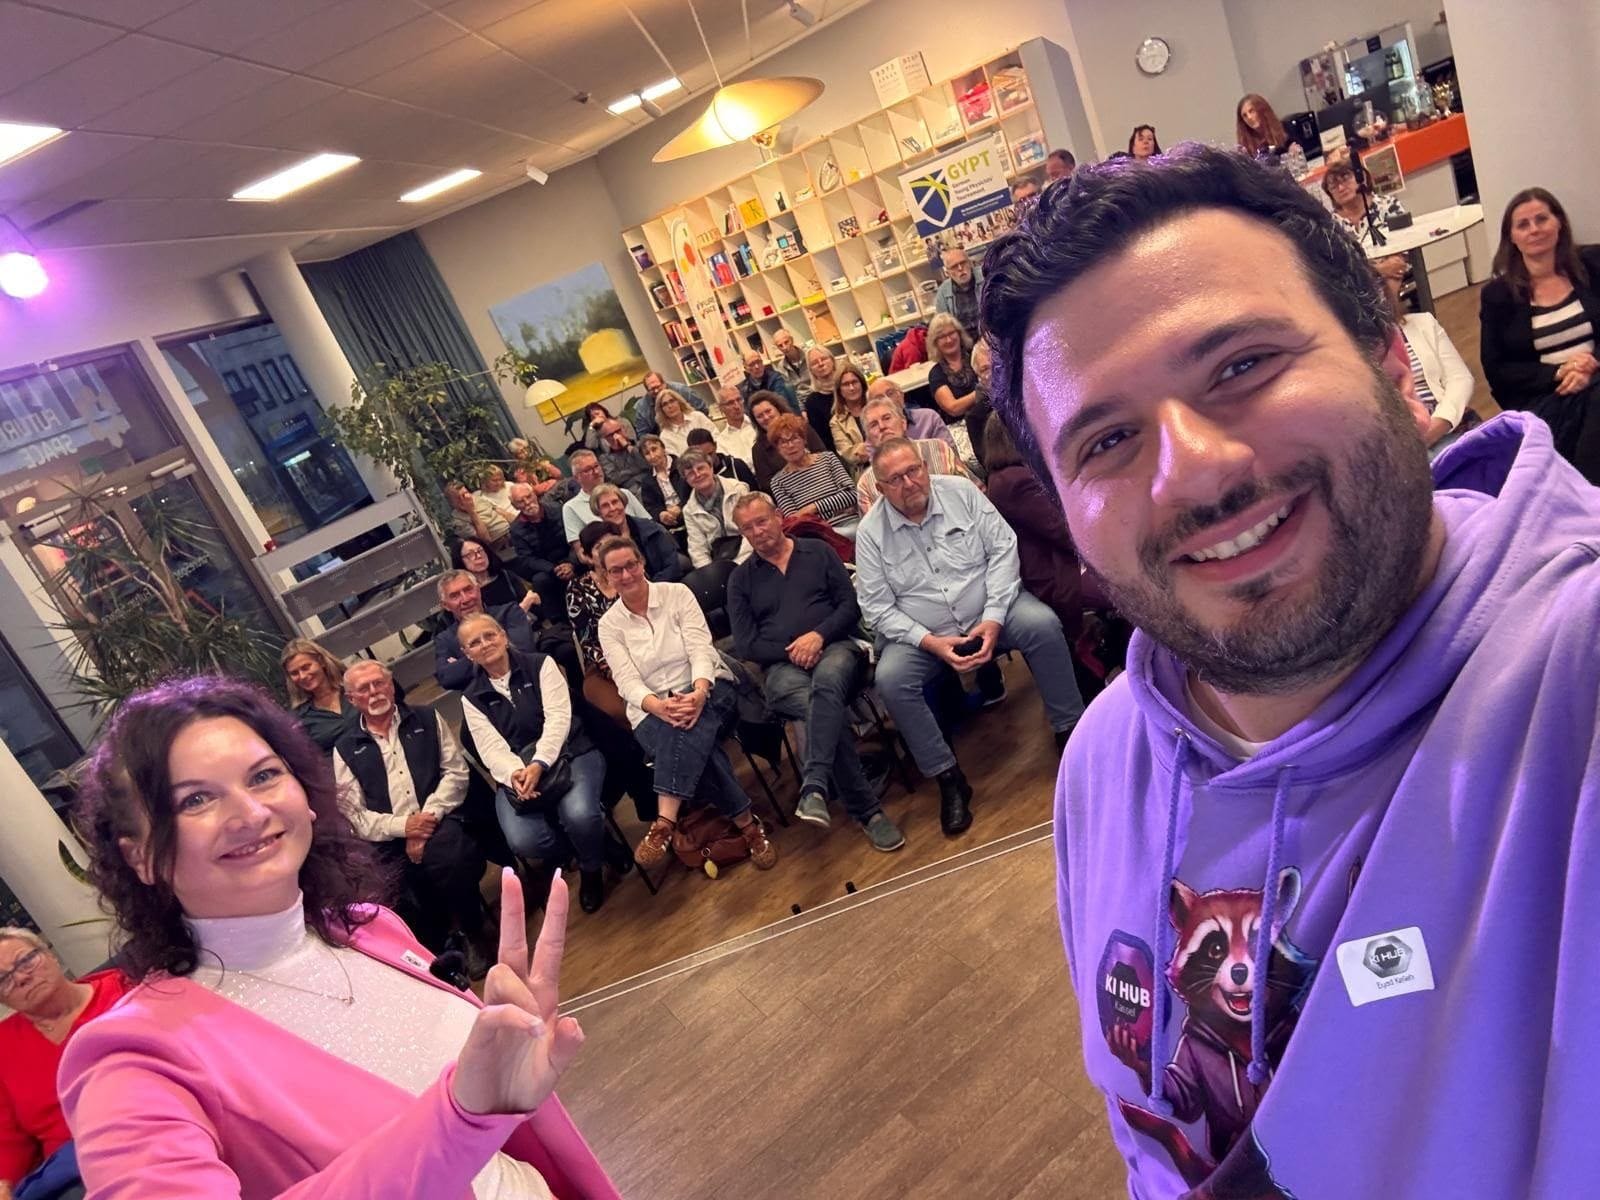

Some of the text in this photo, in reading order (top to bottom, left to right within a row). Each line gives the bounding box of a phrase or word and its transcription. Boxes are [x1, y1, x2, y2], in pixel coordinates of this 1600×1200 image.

[947, 150, 990, 180] GYPT
[1369, 953, 1380, 964] KI
[1105, 974, 1150, 1008] KI HUB
